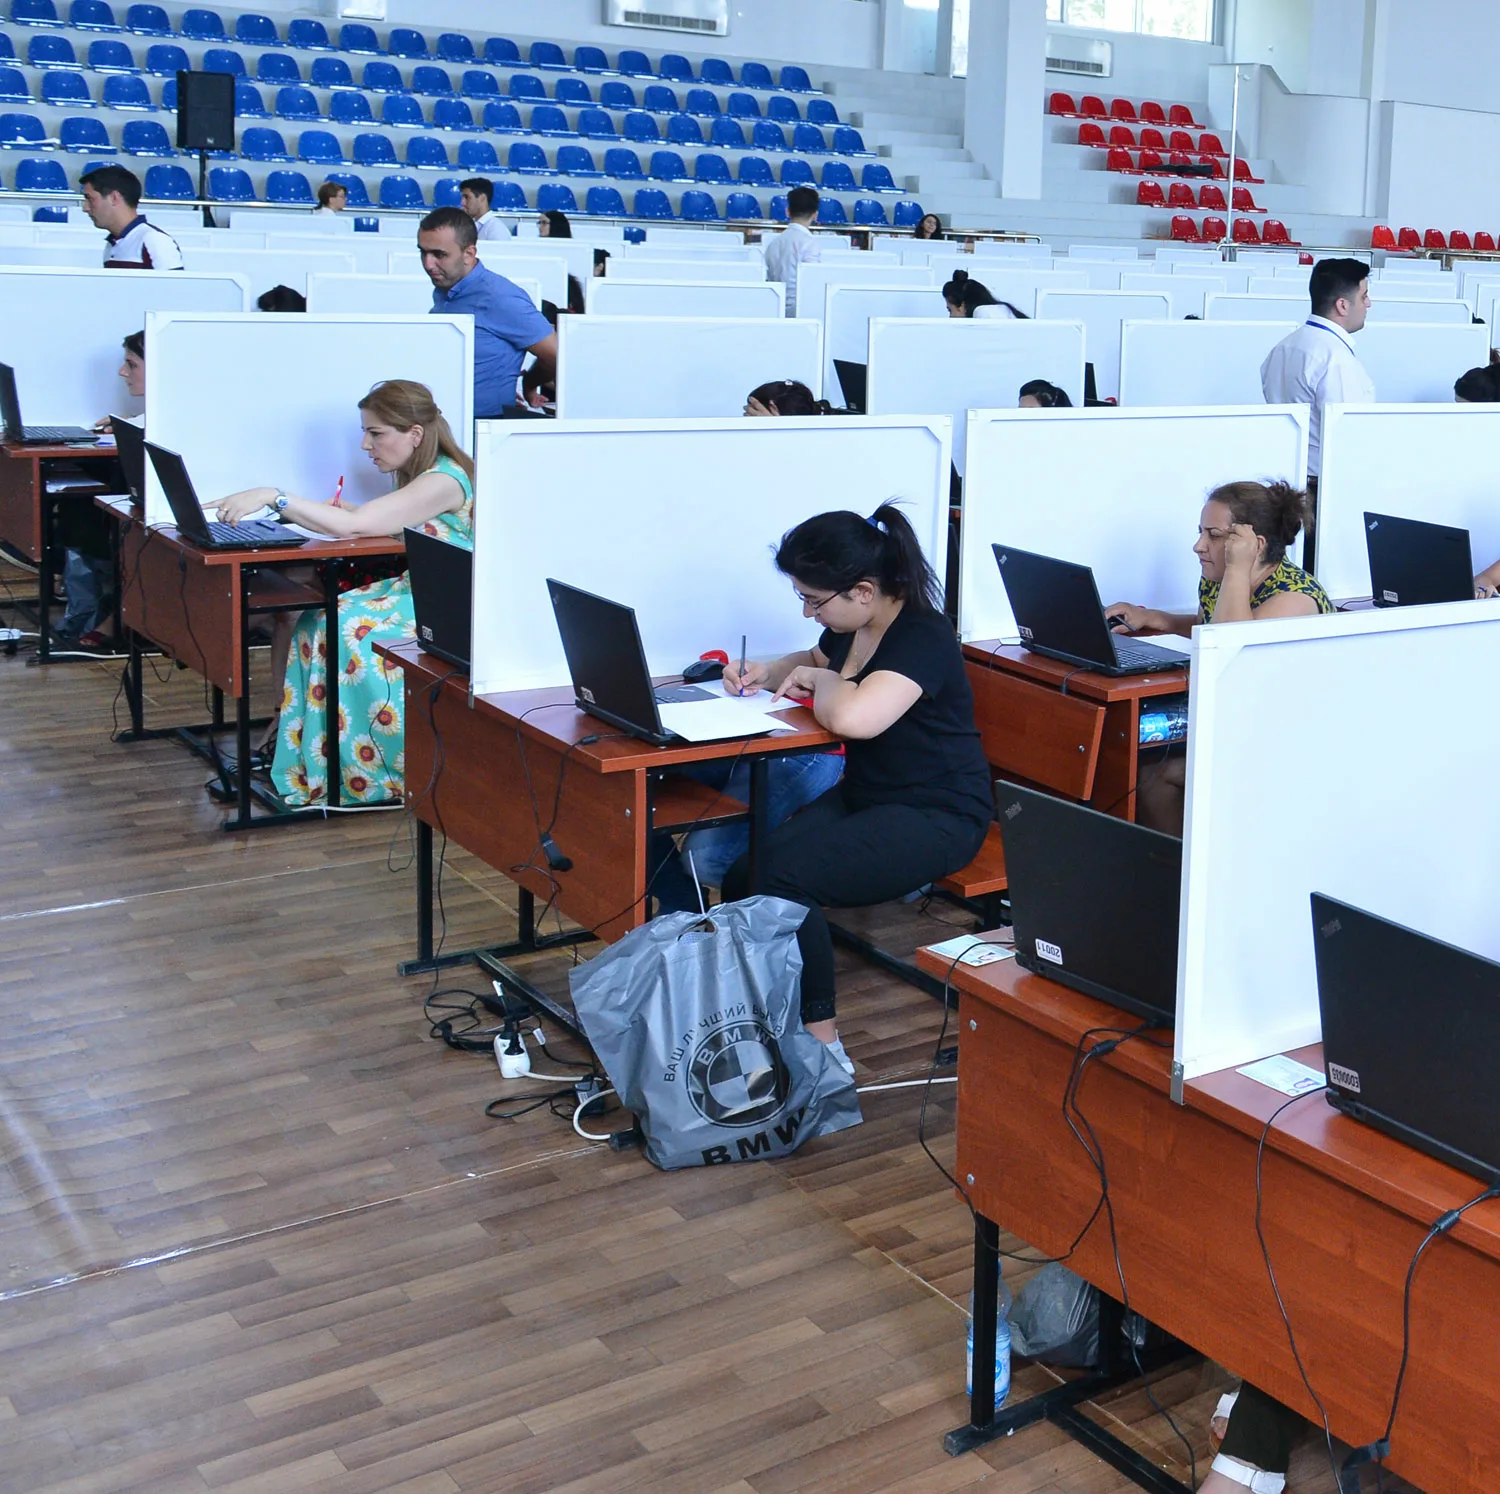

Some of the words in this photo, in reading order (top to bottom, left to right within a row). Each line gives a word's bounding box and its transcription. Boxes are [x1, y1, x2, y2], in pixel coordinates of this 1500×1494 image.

[664, 1047, 685, 1082] ВАШ
[682, 1002, 747, 1046] ЛЧШИЙ
[701, 1106, 806, 1166] BMW
